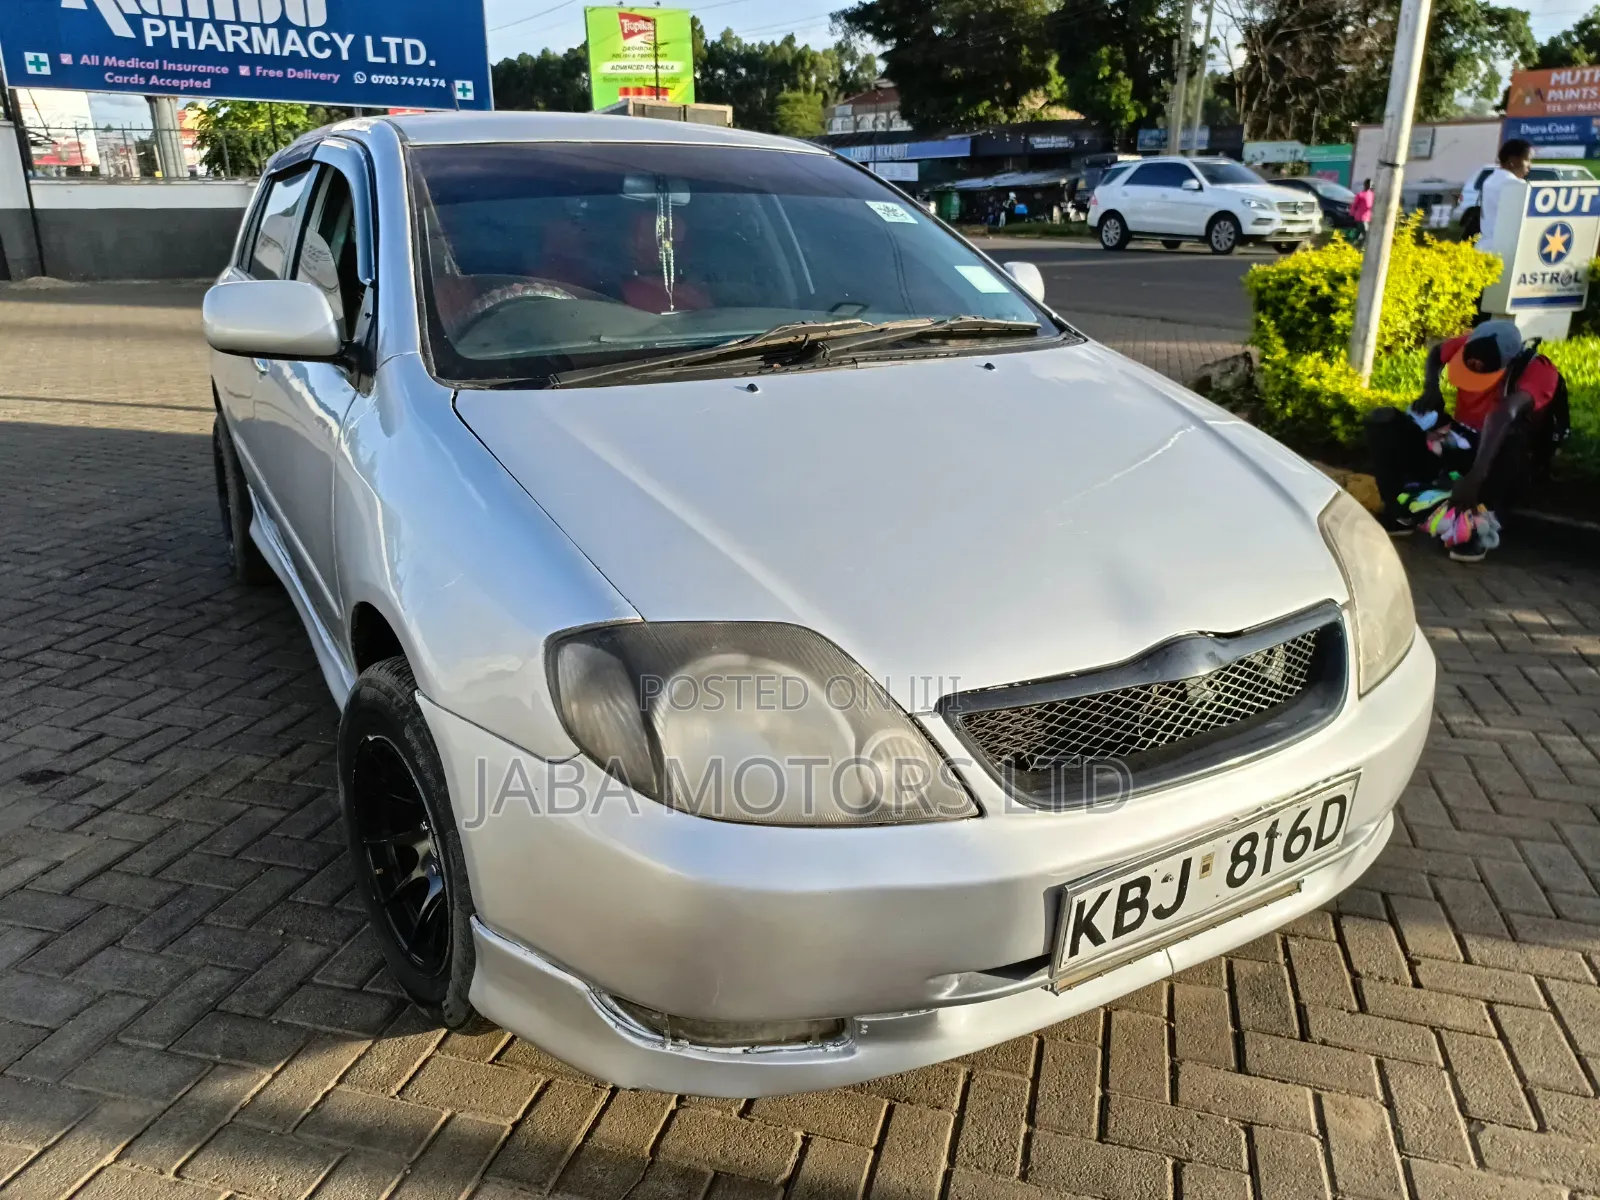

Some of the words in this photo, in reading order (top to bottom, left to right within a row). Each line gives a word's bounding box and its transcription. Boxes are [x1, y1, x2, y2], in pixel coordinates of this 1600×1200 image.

[143, 18, 355, 61] PHARMACY
[365, 35, 436, 67] LTD.
[80, 54, 99, 66] All
[103, 56, 159, 70] Medical
[163, 60, 229, 75] Insurance
[256, 66, 284, 79] Free
[287, 68, 341, 84] Delivery
[104, 72, 146, 85] Cards
[149, 77, 211, 90] Accepted
[1548, 88, 1599, 101] PAINTS
[1534, 186, 1600, 214] OUT
[1068, 857, 1192, 959] KBJ
[1225, 794, 1347, 889] 816D
